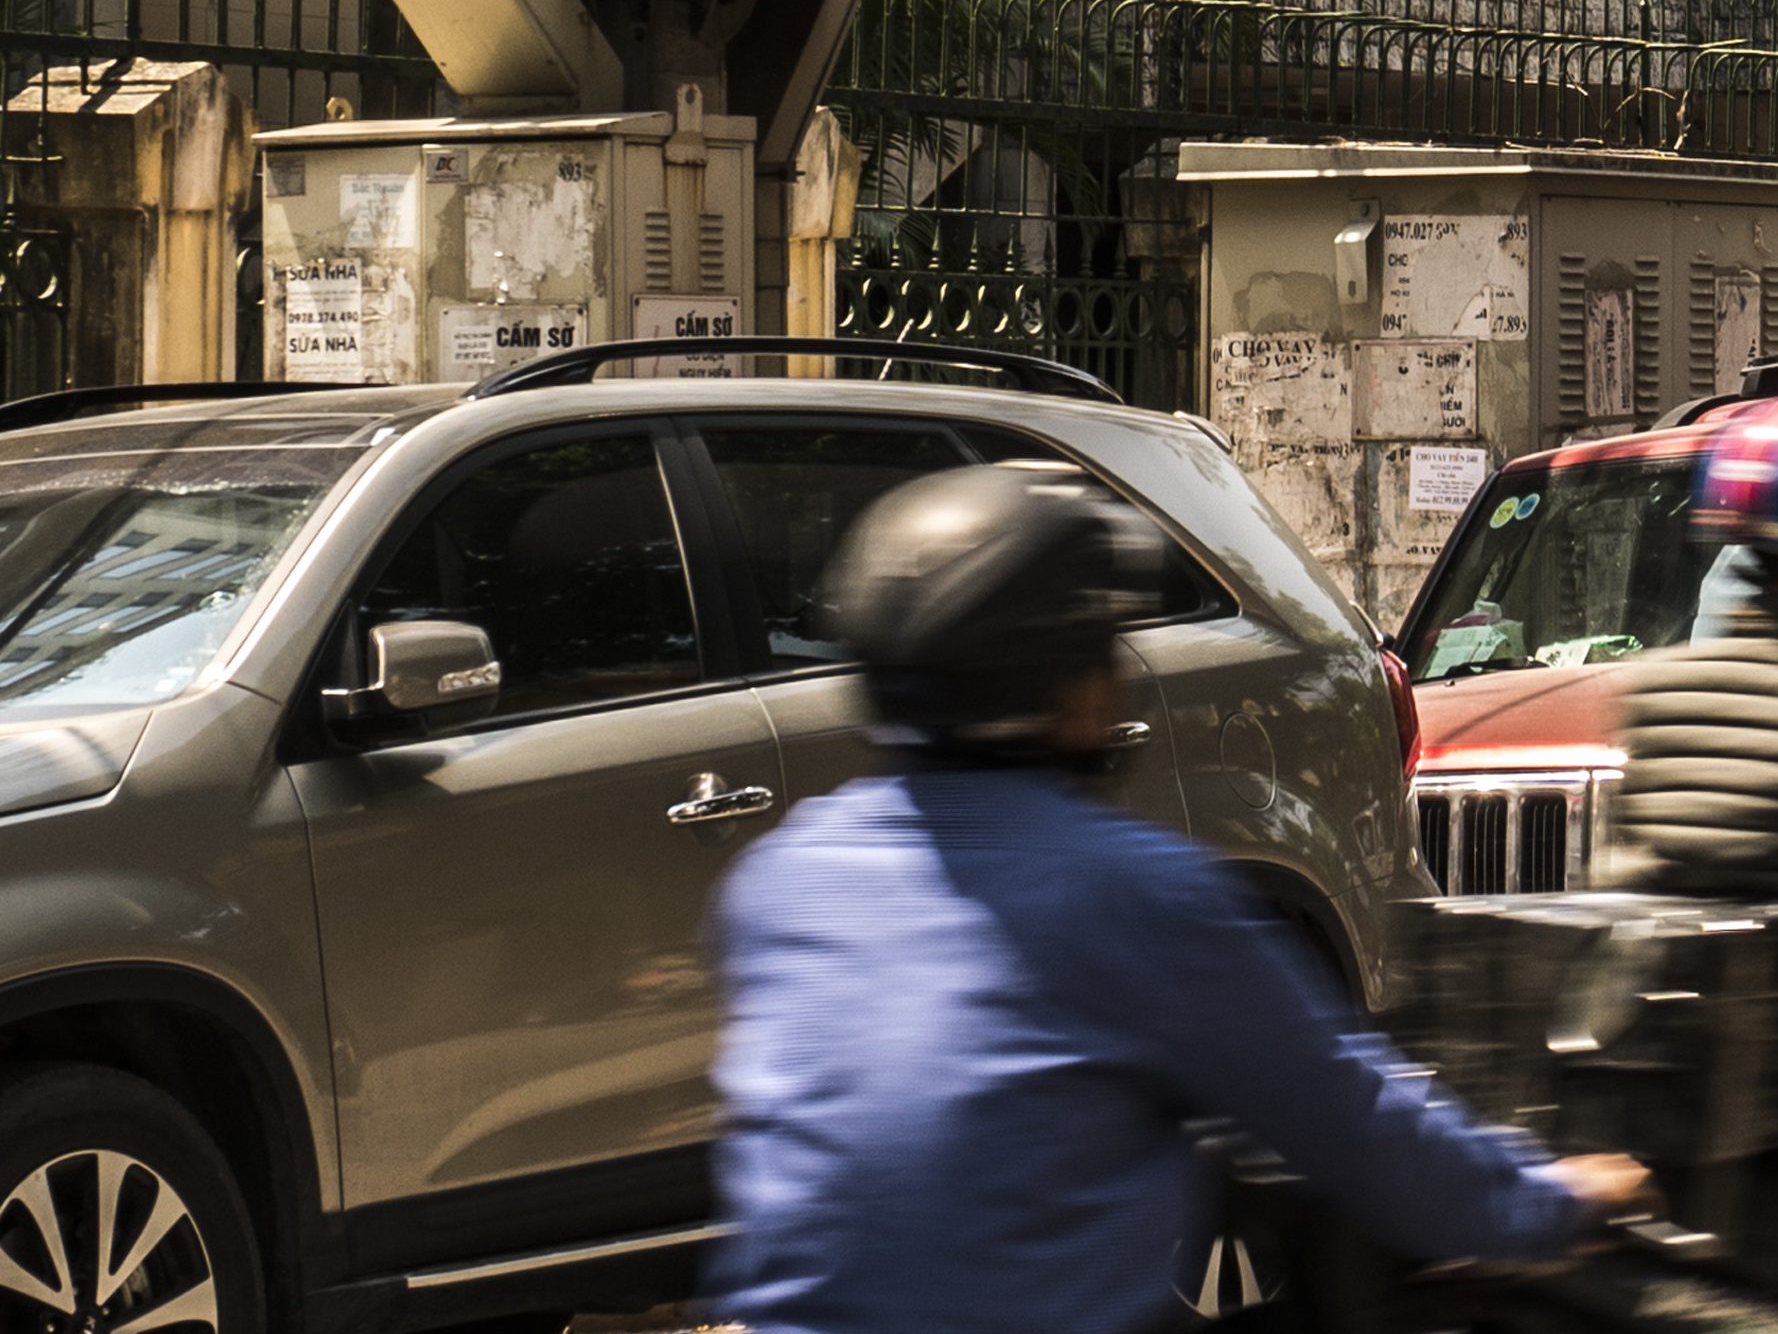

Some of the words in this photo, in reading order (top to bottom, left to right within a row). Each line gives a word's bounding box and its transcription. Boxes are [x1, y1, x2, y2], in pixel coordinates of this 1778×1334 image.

[497, 320, 541, 347] CẤM
[547, 322, 575, 348] SỜ
[675, 310, 708, 337] CẤM
[713, 312, 733, 337] SỜ
